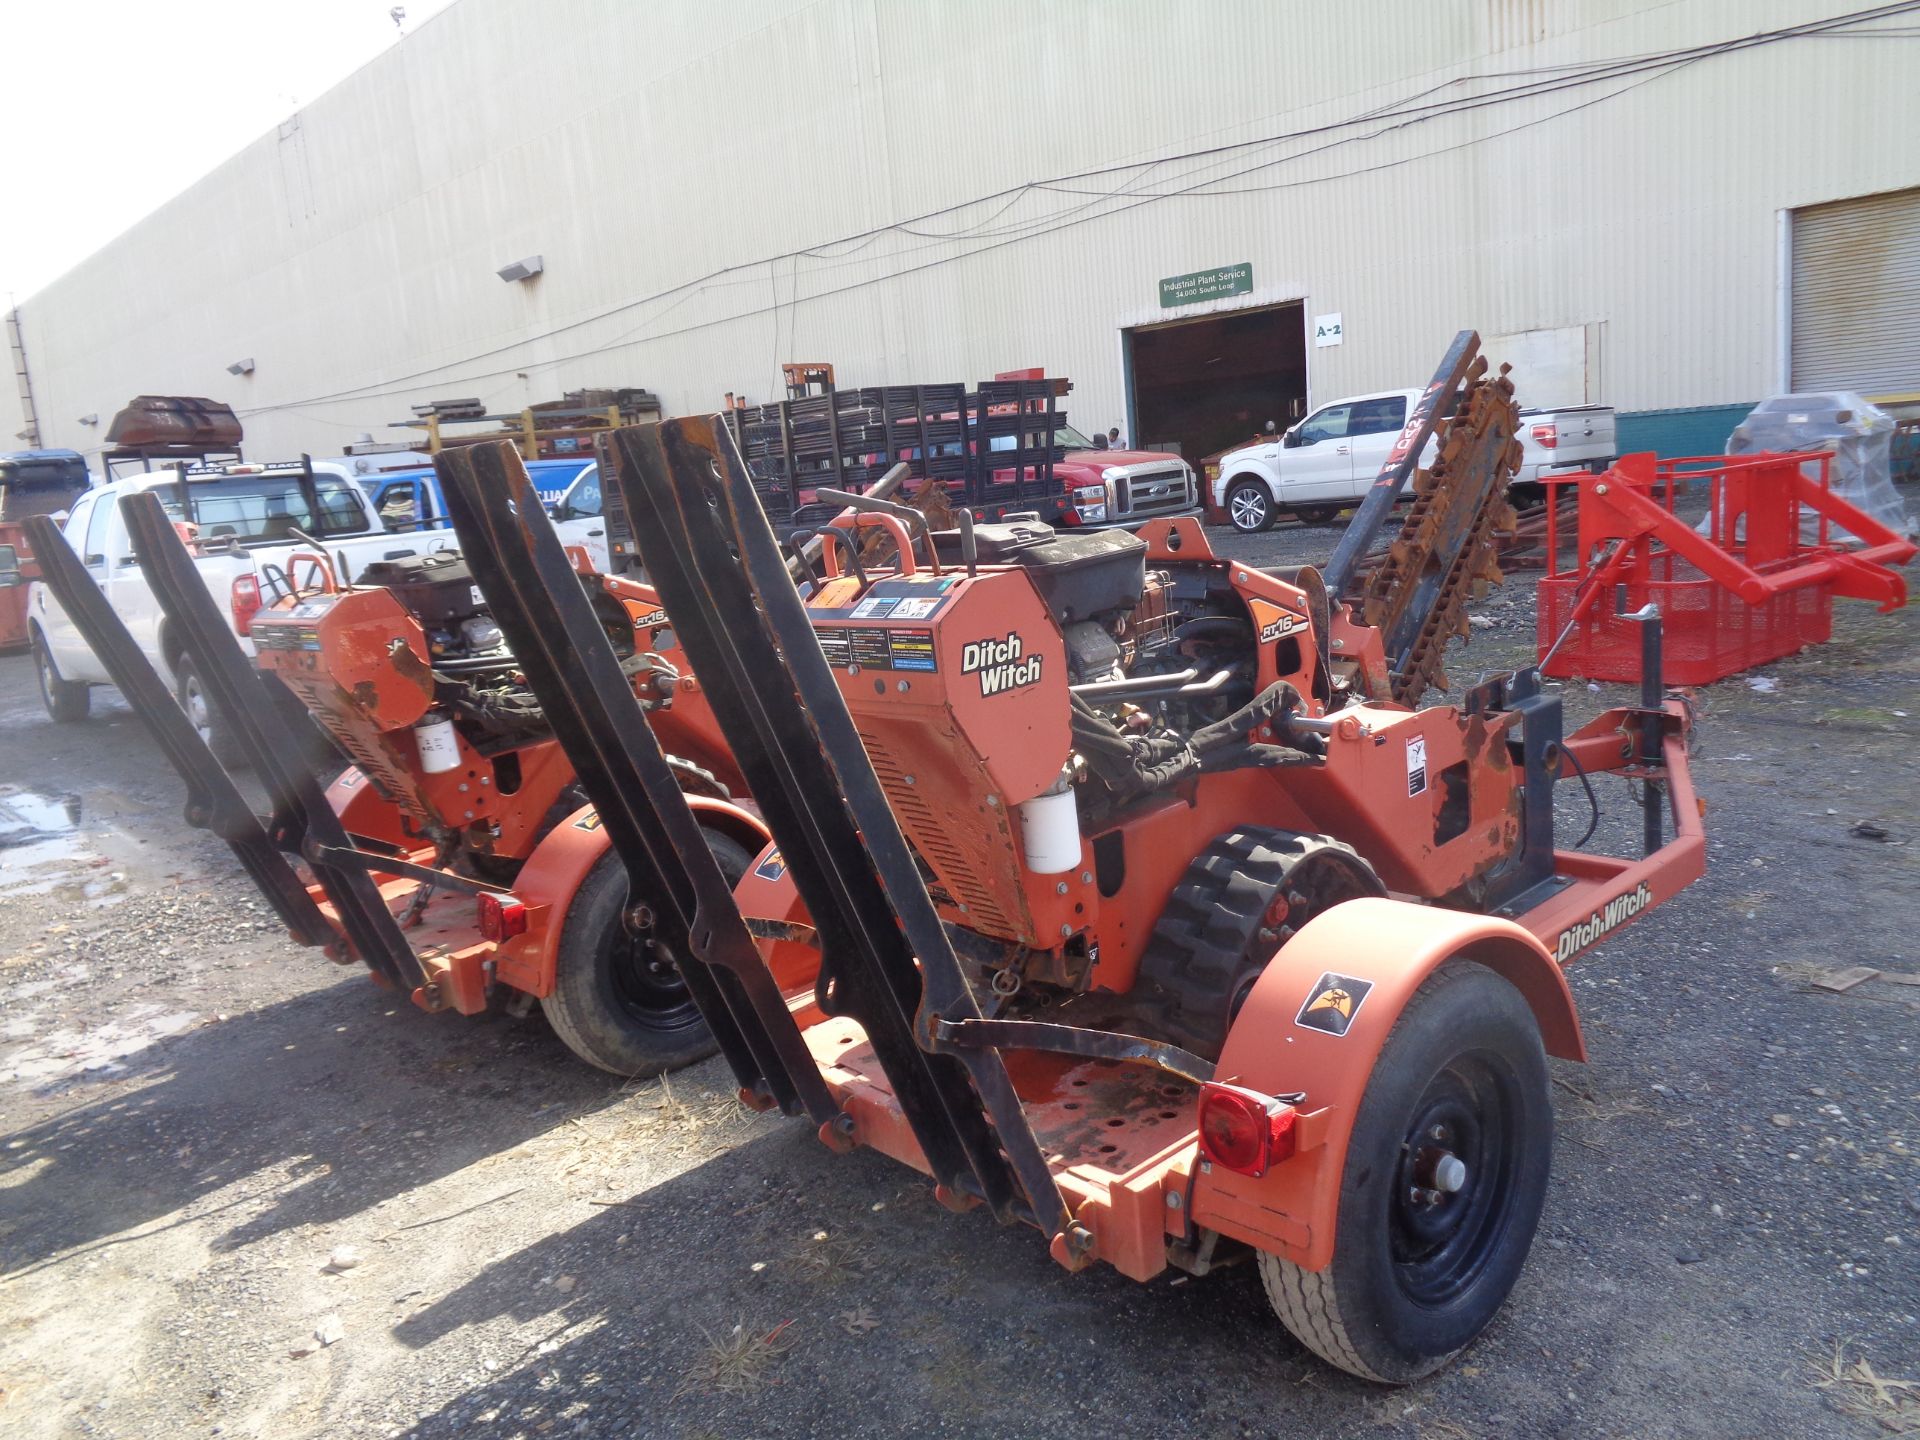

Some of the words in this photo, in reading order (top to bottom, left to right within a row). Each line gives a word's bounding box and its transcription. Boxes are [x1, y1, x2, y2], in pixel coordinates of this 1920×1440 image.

[1163, 278, 1196, 292] Industrial
[1197, 275, 1216, 286] Plant
[1218, 269, 1246, 281] Service
[1199, 285, 1217, 294] South
[1316, 324, 1341, 337] A-2
[963, 634, 1021, 672] Ditch
[981, 657, 1040, 695] Witch
[1557, 913, 1600, 963] Ditch
[1604, 884, 1646, 931] Witch
